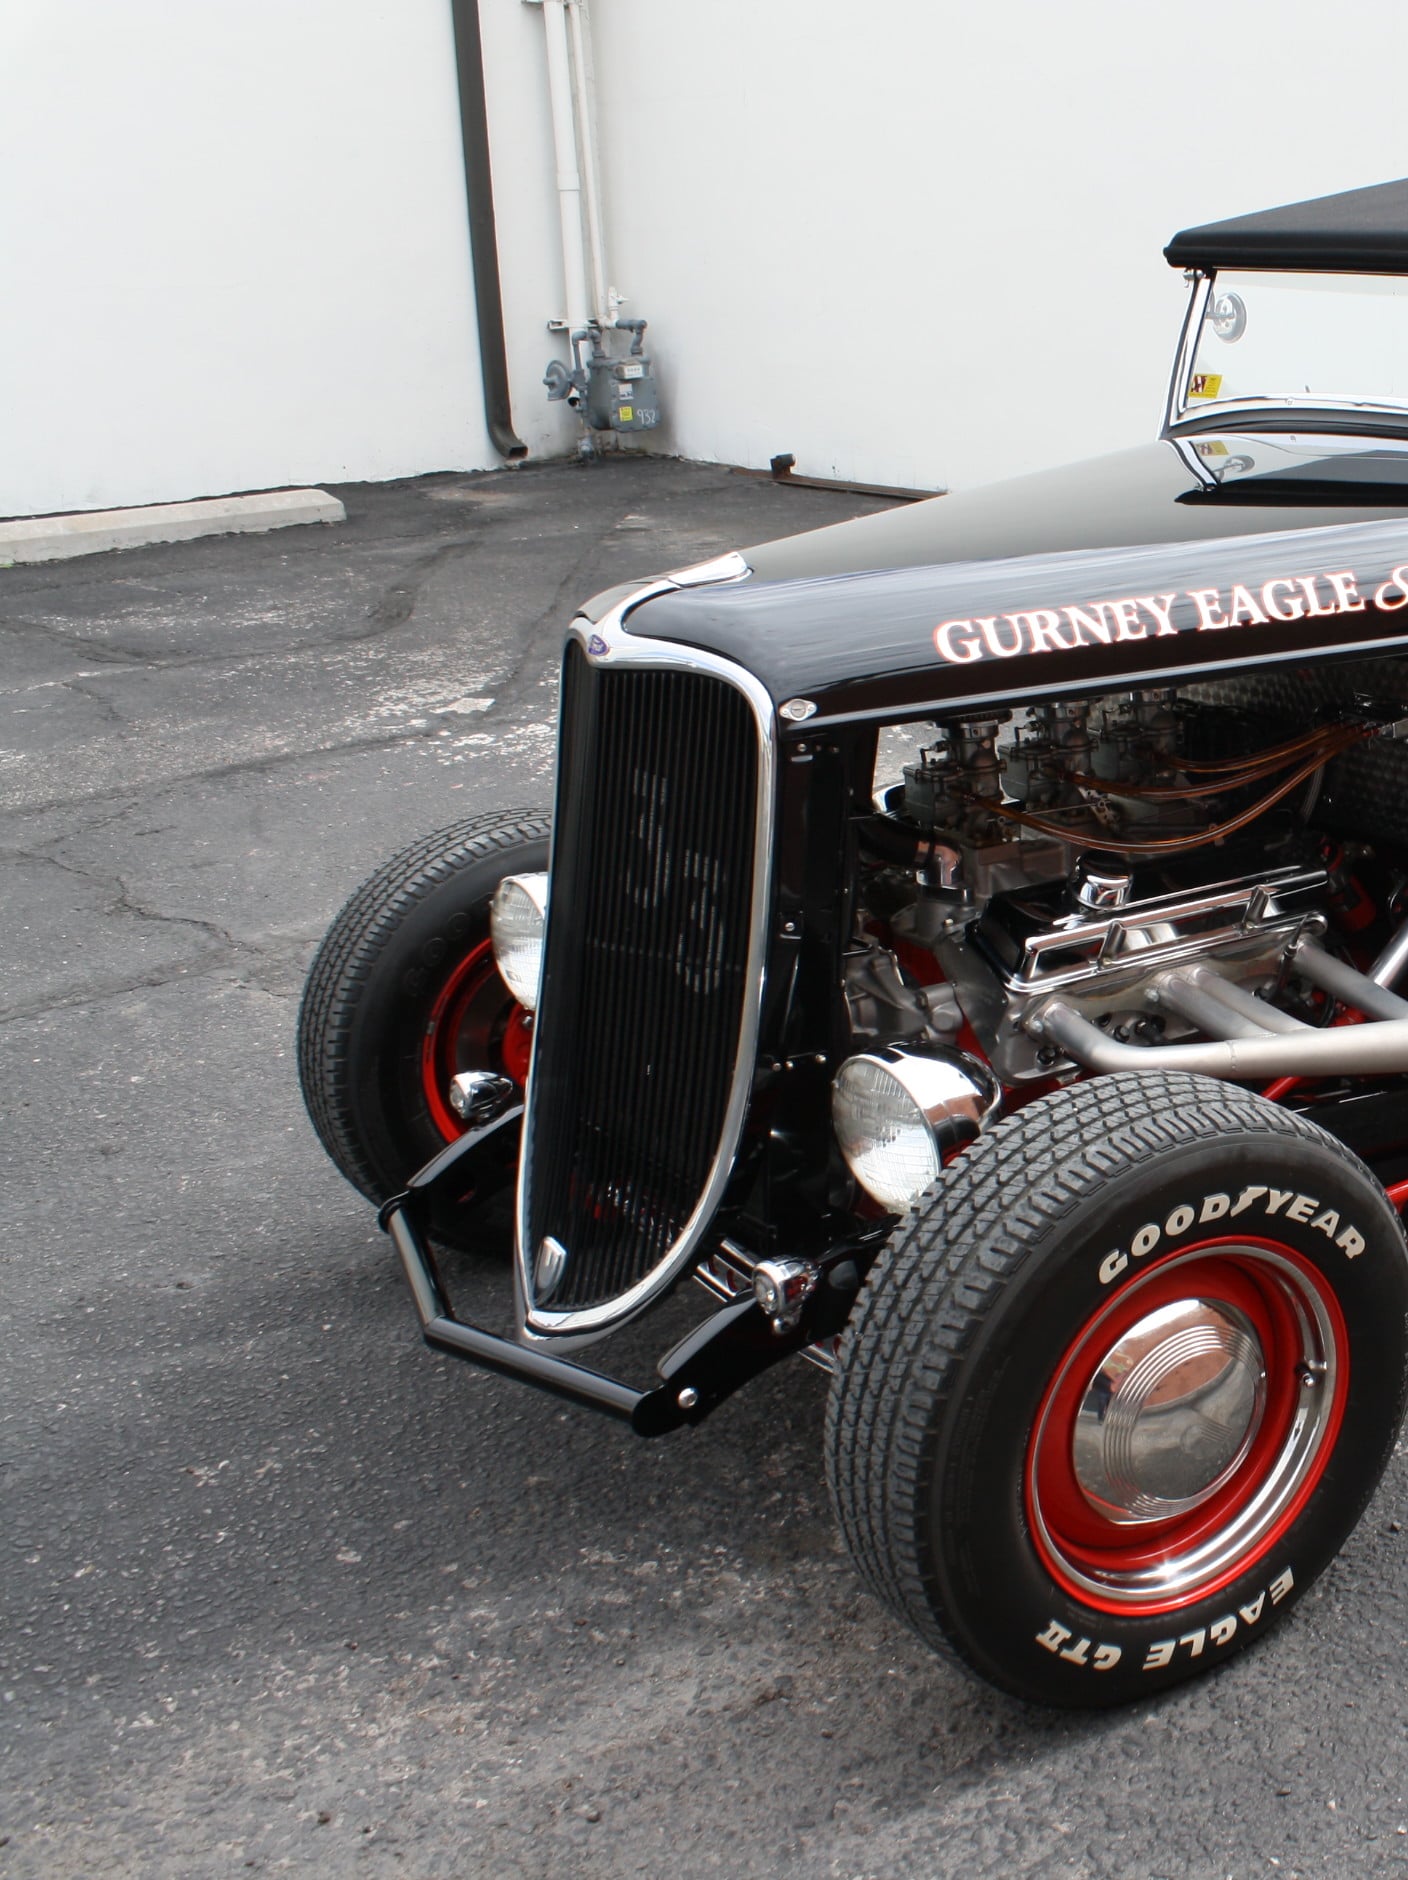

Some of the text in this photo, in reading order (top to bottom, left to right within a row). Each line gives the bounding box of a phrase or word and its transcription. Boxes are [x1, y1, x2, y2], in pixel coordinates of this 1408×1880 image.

[933, 593, 1180, 665] GURNEY
[1186, 570, 1366, 632] EAGLE
[1098, 1185, 1366, 1285] GOODYEAR
[1141, 1564, 1295, 1671] EAGLE
